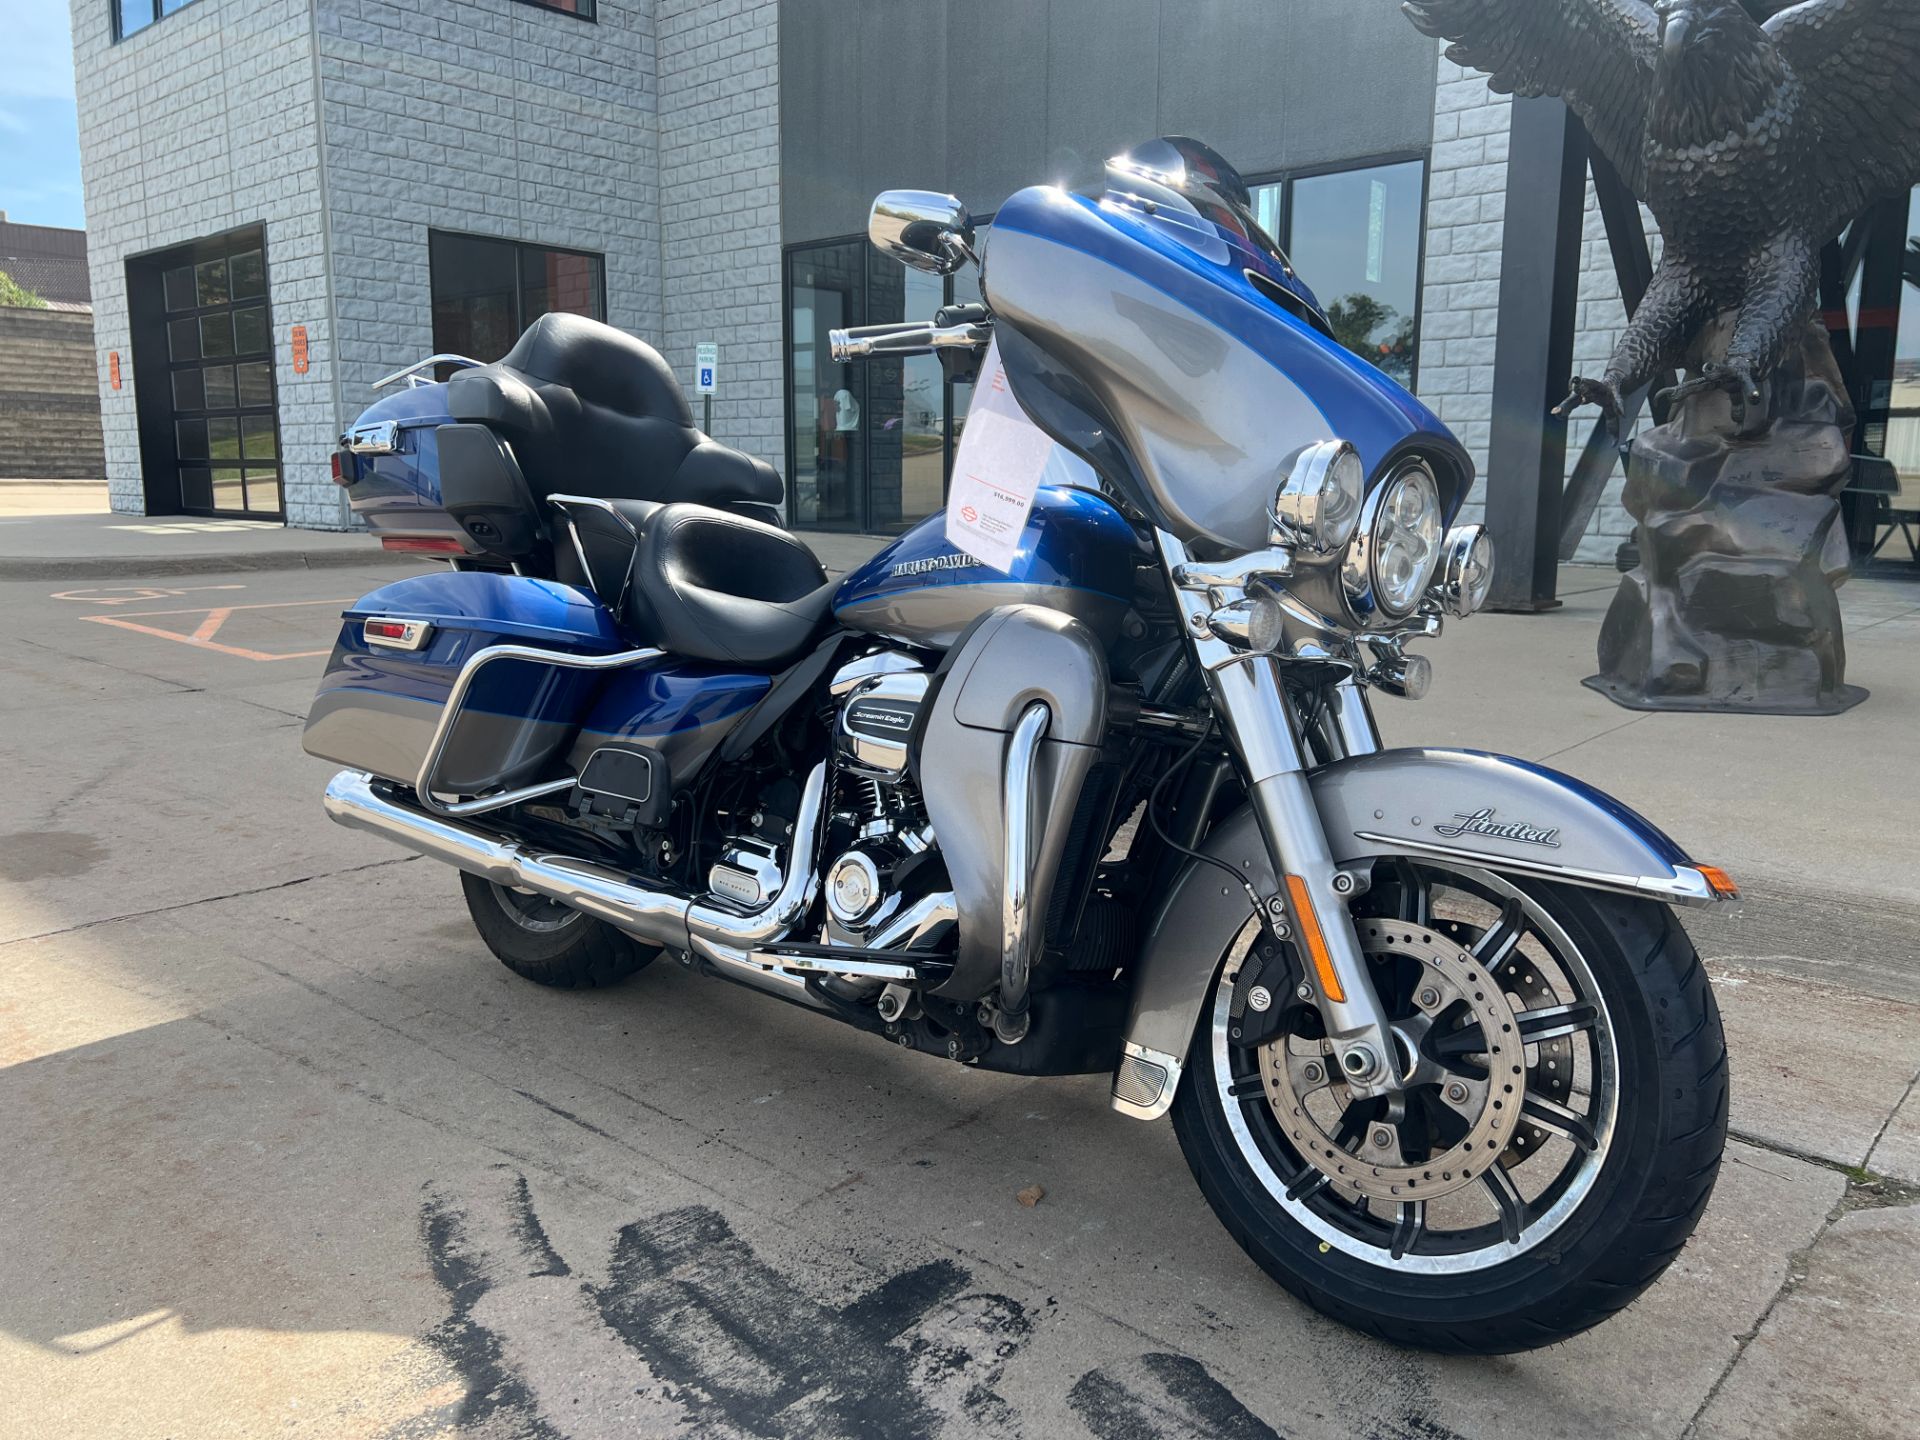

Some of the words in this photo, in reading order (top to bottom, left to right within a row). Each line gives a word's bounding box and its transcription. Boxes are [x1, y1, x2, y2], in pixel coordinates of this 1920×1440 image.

[892, 553, 984, 577] HARLEY-DAVIDS
[884, 715, 905, 724] Eagle
[1433, 807, 1561, 848] Limited
